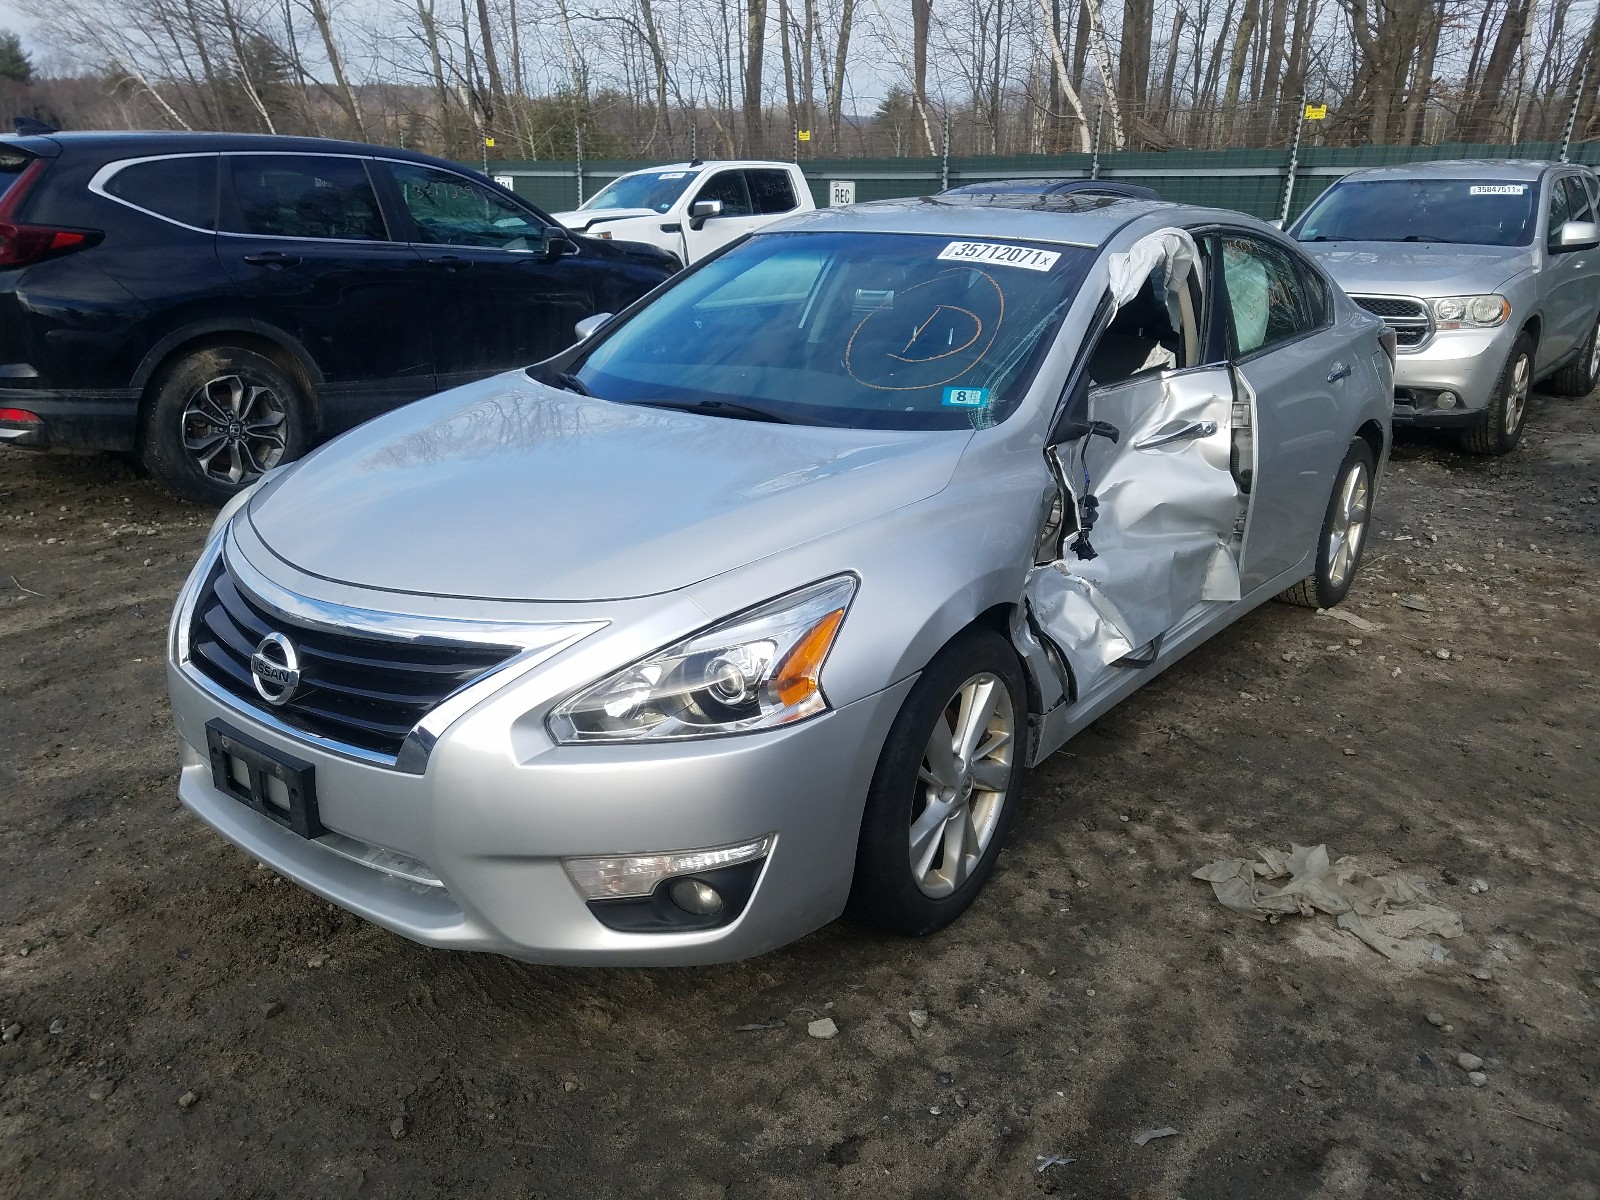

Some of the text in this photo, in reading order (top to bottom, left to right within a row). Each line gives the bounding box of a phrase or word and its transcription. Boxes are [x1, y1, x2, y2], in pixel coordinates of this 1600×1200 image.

[834, 188, 850, 204] REC
[956, 390, 967, 402] 8
[252, 659, 289, 683] NISSAN
